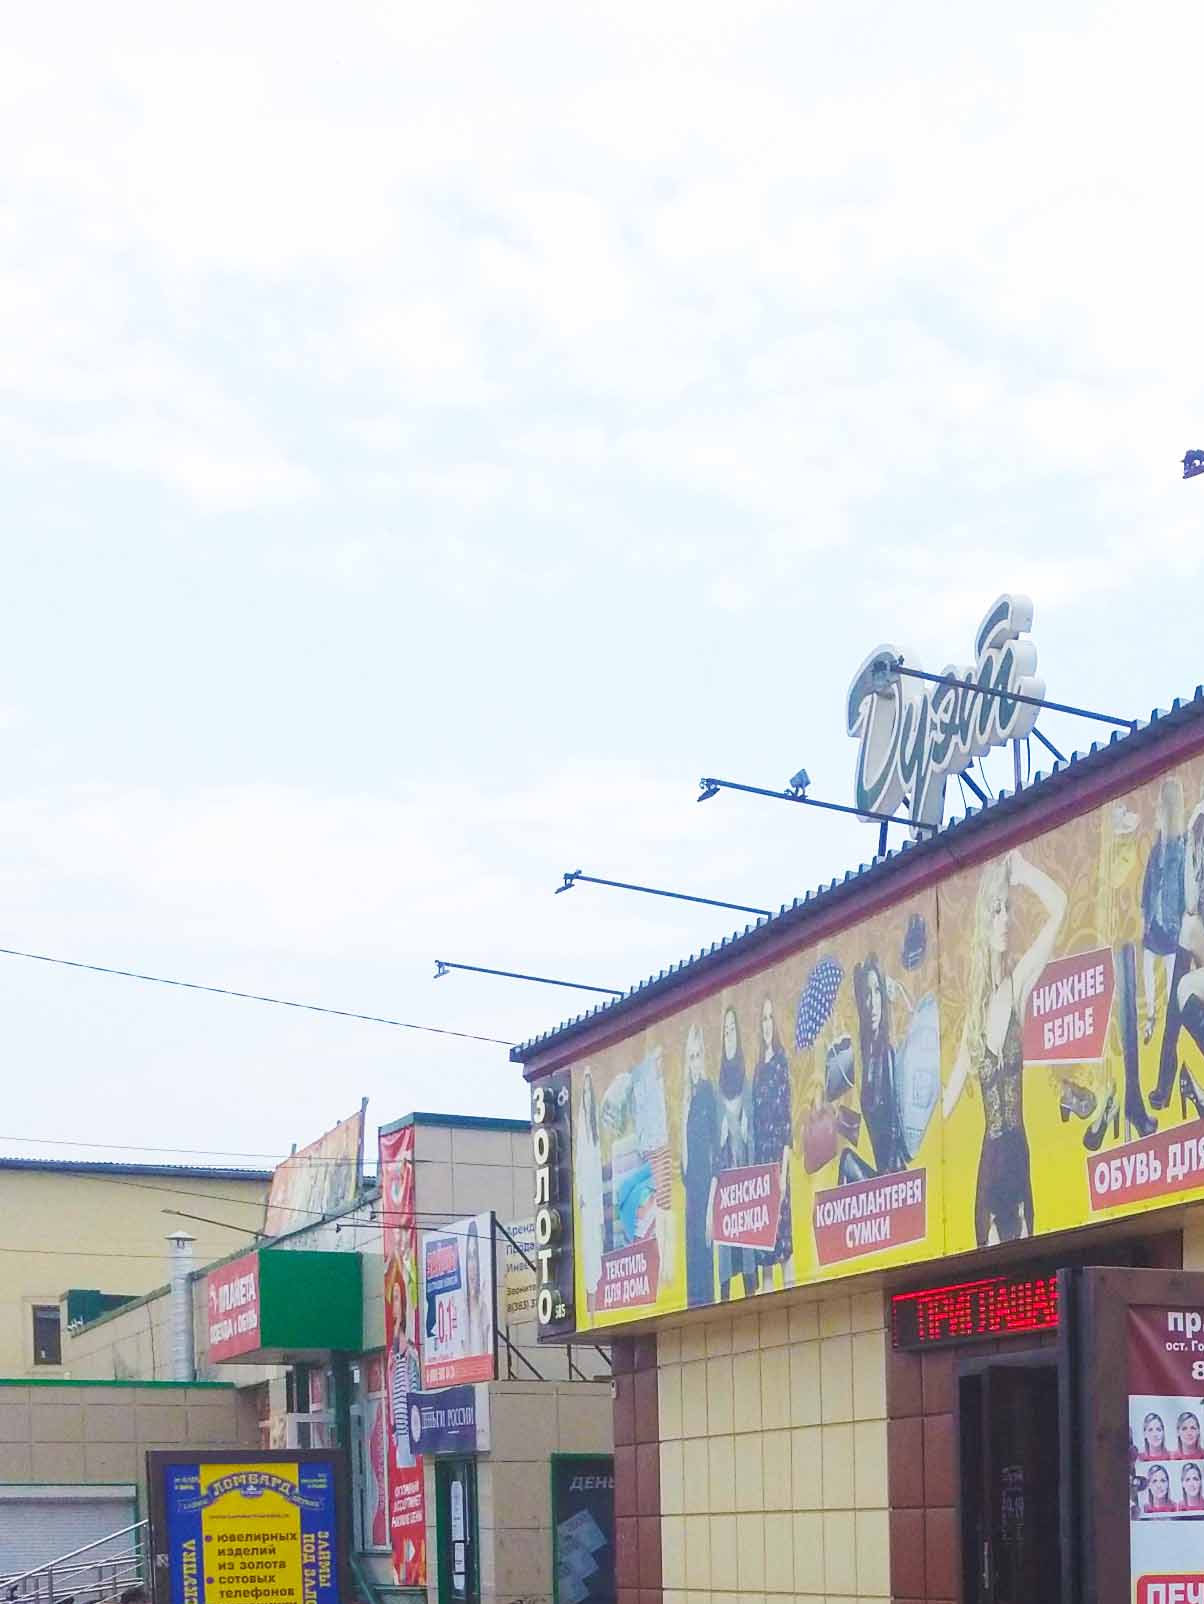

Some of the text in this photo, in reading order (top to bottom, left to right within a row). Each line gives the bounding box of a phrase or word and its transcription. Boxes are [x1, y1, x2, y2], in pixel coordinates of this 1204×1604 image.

[1032, 964, 1105, 1017] НИЖНЕЕ
[1043, 1007, 1095, 1050] БЕЛЬЕ
[1094, 1152, 1161, 1194] ОБУВЬ
[719, 1173, 772, 1207] ЖЕНСКАЯ
[816, 1177, 923, 1228] КОЖГАЛАНТЕРЕЯ
[533, 1087, 552, 1325] ЗОЛОТО
[722, 1203, 770, 1238] ОДЕЖДА
[845, 1220, 892, 1249] СУМКИ
[605, 1252, 648, 1284] ТЕКСТИЛЬ
[604, 1277, 651, 1306] ДЛЯ ДОМА
[1165, 1341, 1188, 1353] ост.
[213, 1473, 292, 1497] ЛОМБАРД
[217, 1532, 297, 1544] ювелирных
[218, 1544, 277, 1558] изделий
[303, 1533, 316, 1563] ПОД
[218, 1560, 287, 1571] из золота
[218, 1574, 276, 1585] сотовых
[219, 1587, 295, 1600] телефонов
